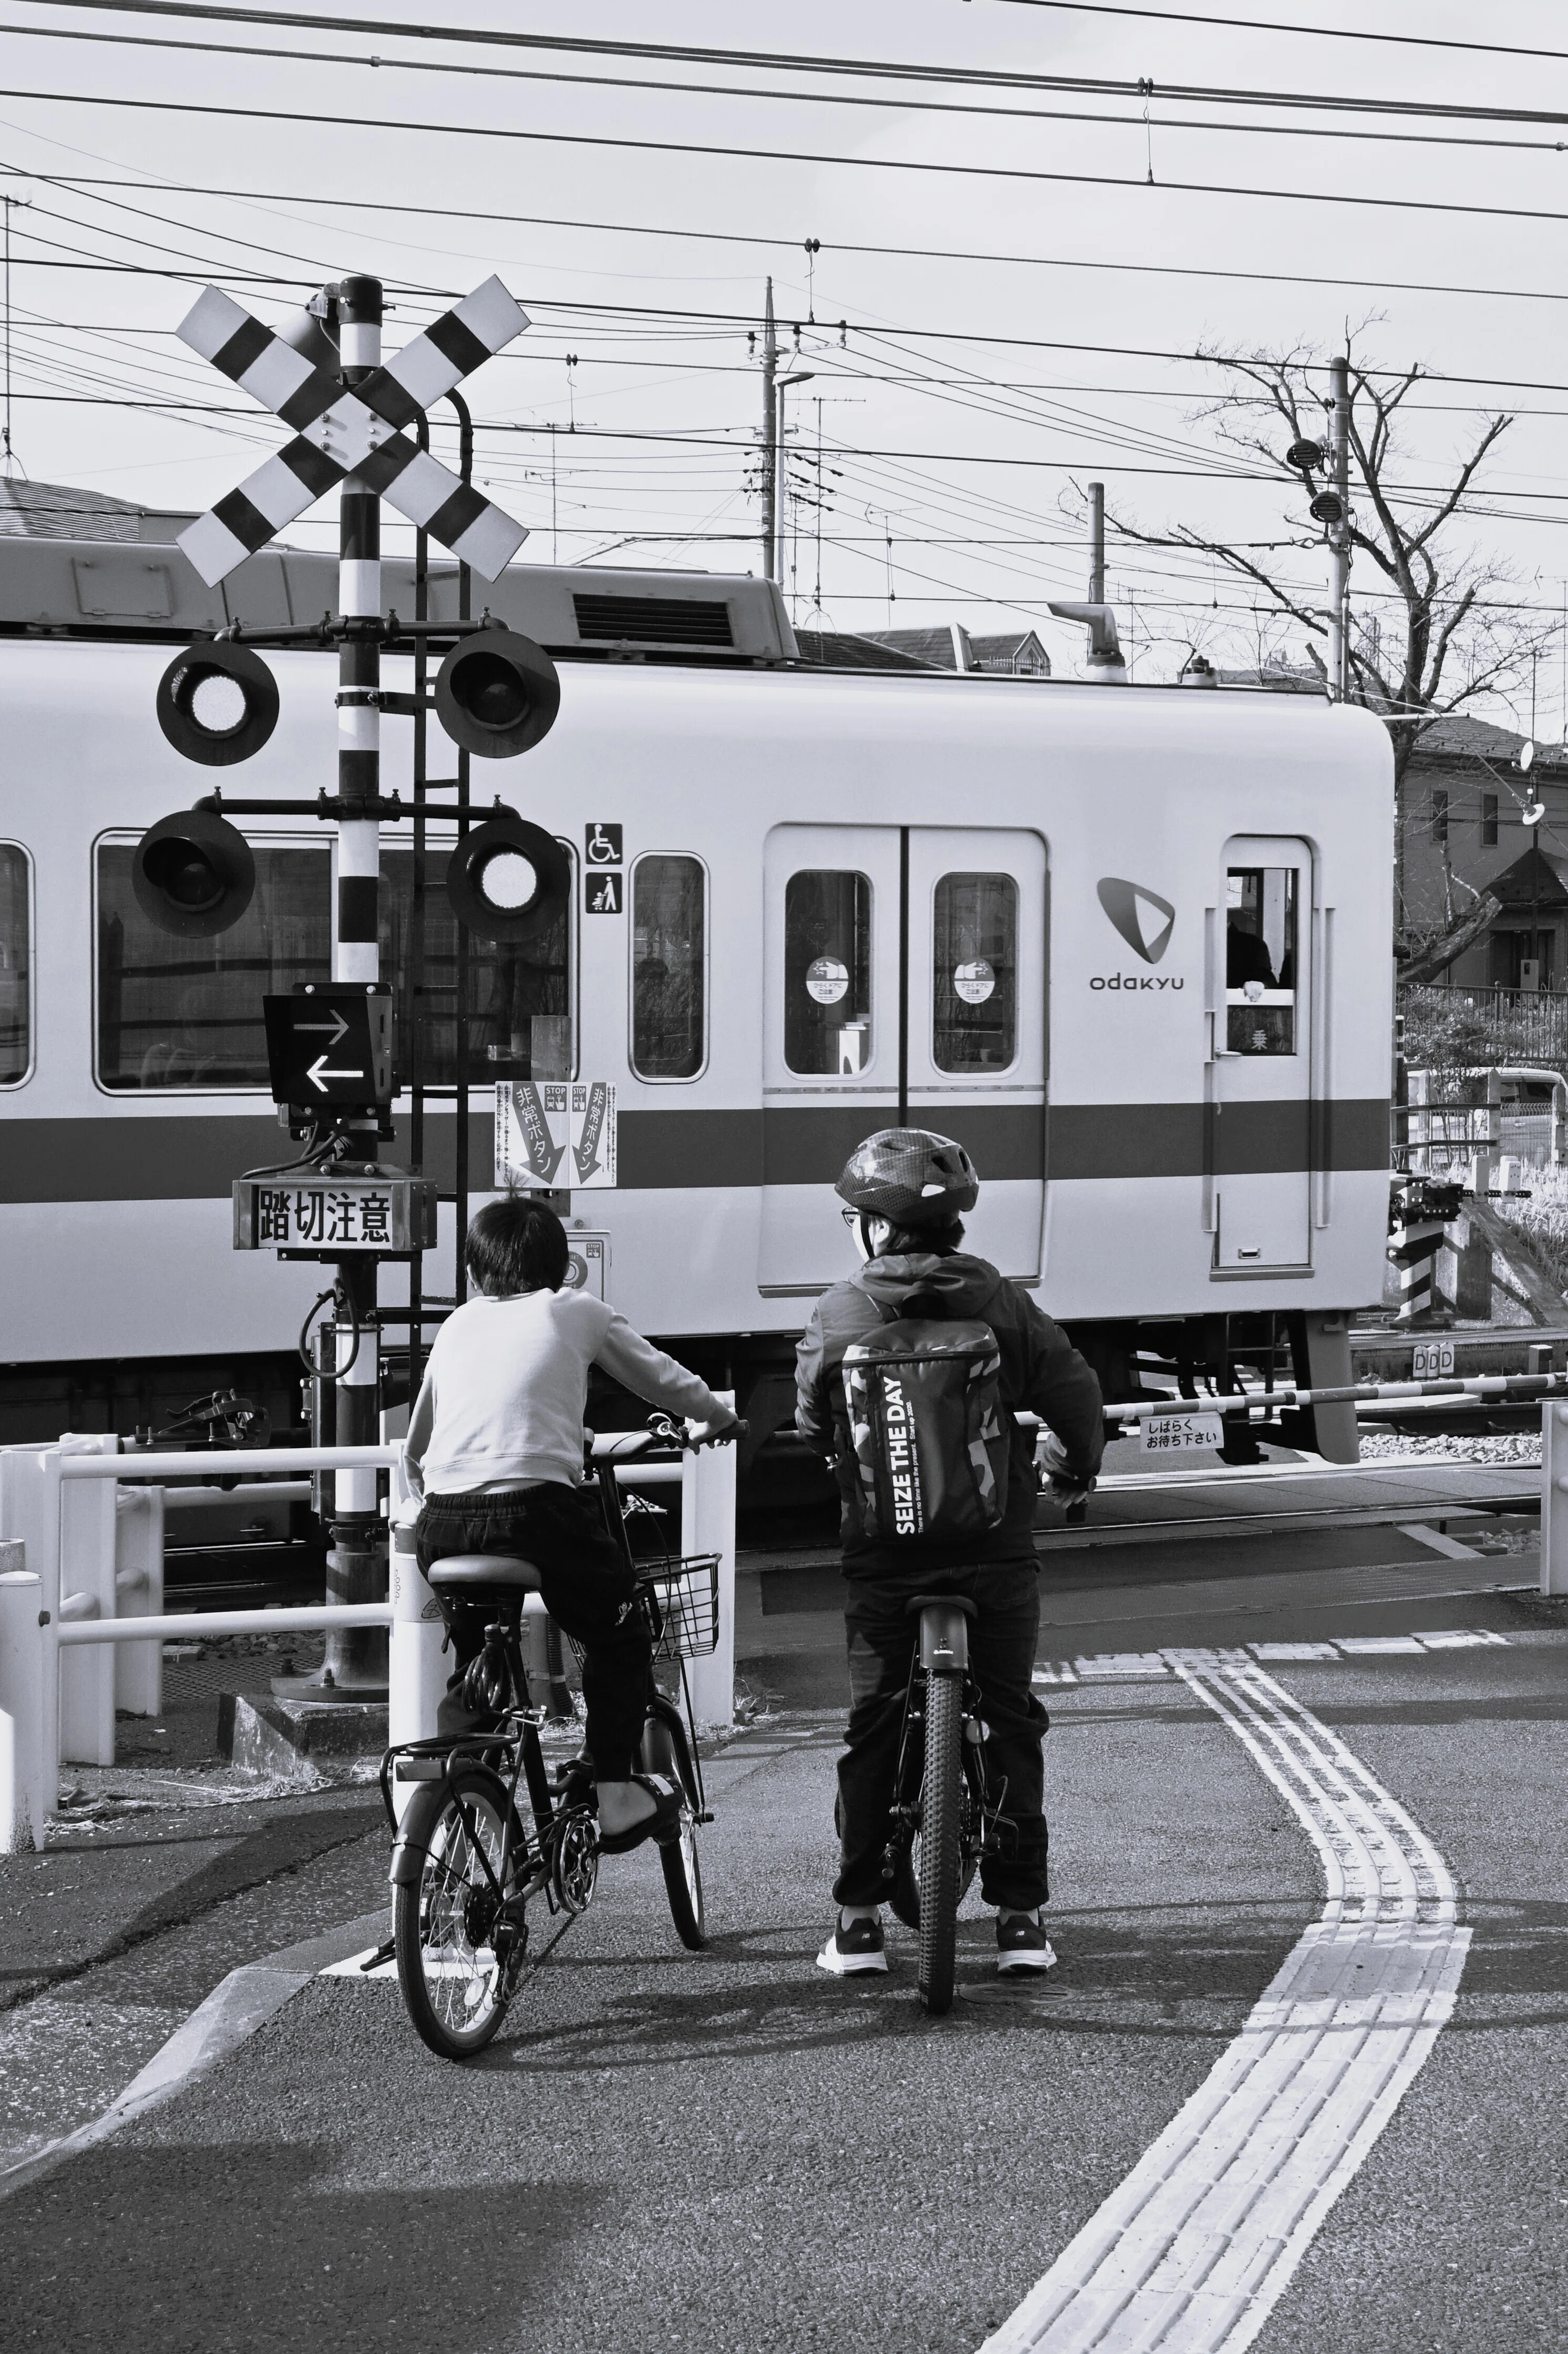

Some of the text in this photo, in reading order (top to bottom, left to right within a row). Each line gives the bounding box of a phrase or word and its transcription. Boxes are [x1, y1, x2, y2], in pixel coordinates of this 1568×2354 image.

[1251, 1029, 1268, 1050] 乗
[516, 1087, 551, 1174] 非常ボタン
[580, 1088, 604, 1171] 非常ボタン
[260, 1190, 390, 1243] 踏切注意
[1147, 1431, 1217, 1449] お待ち下さい
[1148, 1419, 1193, 1434] しばらく
[883, 1376, 915, 1534] SEIZE THE DAY
